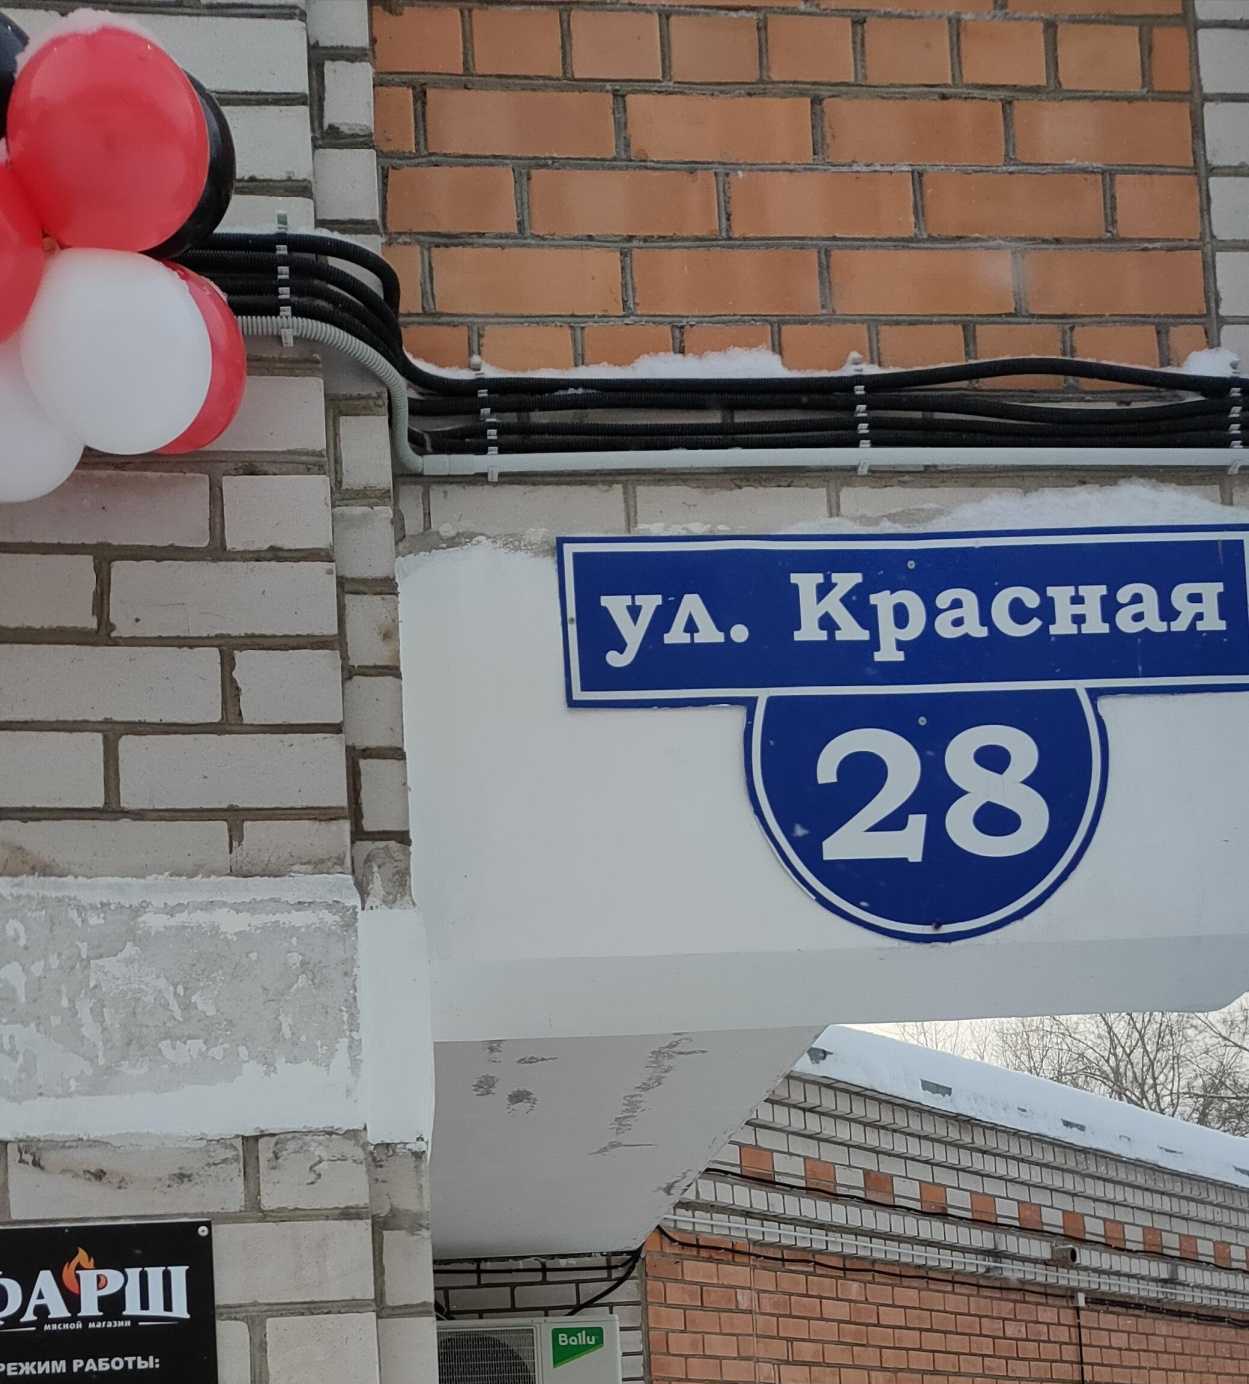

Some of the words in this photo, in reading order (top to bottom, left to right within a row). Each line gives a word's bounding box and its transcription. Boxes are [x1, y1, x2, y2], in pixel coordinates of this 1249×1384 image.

[600, 592, 750, 668] ул.
[790, 571, 1228, 662] Красная
[816, 724, 1050, 862] 28
[43, 1320, 83, 1332] мясной
[88, 1319, 132, 1329] магазин
[72, 1355, 161, 1373] РАБОТЫ:
